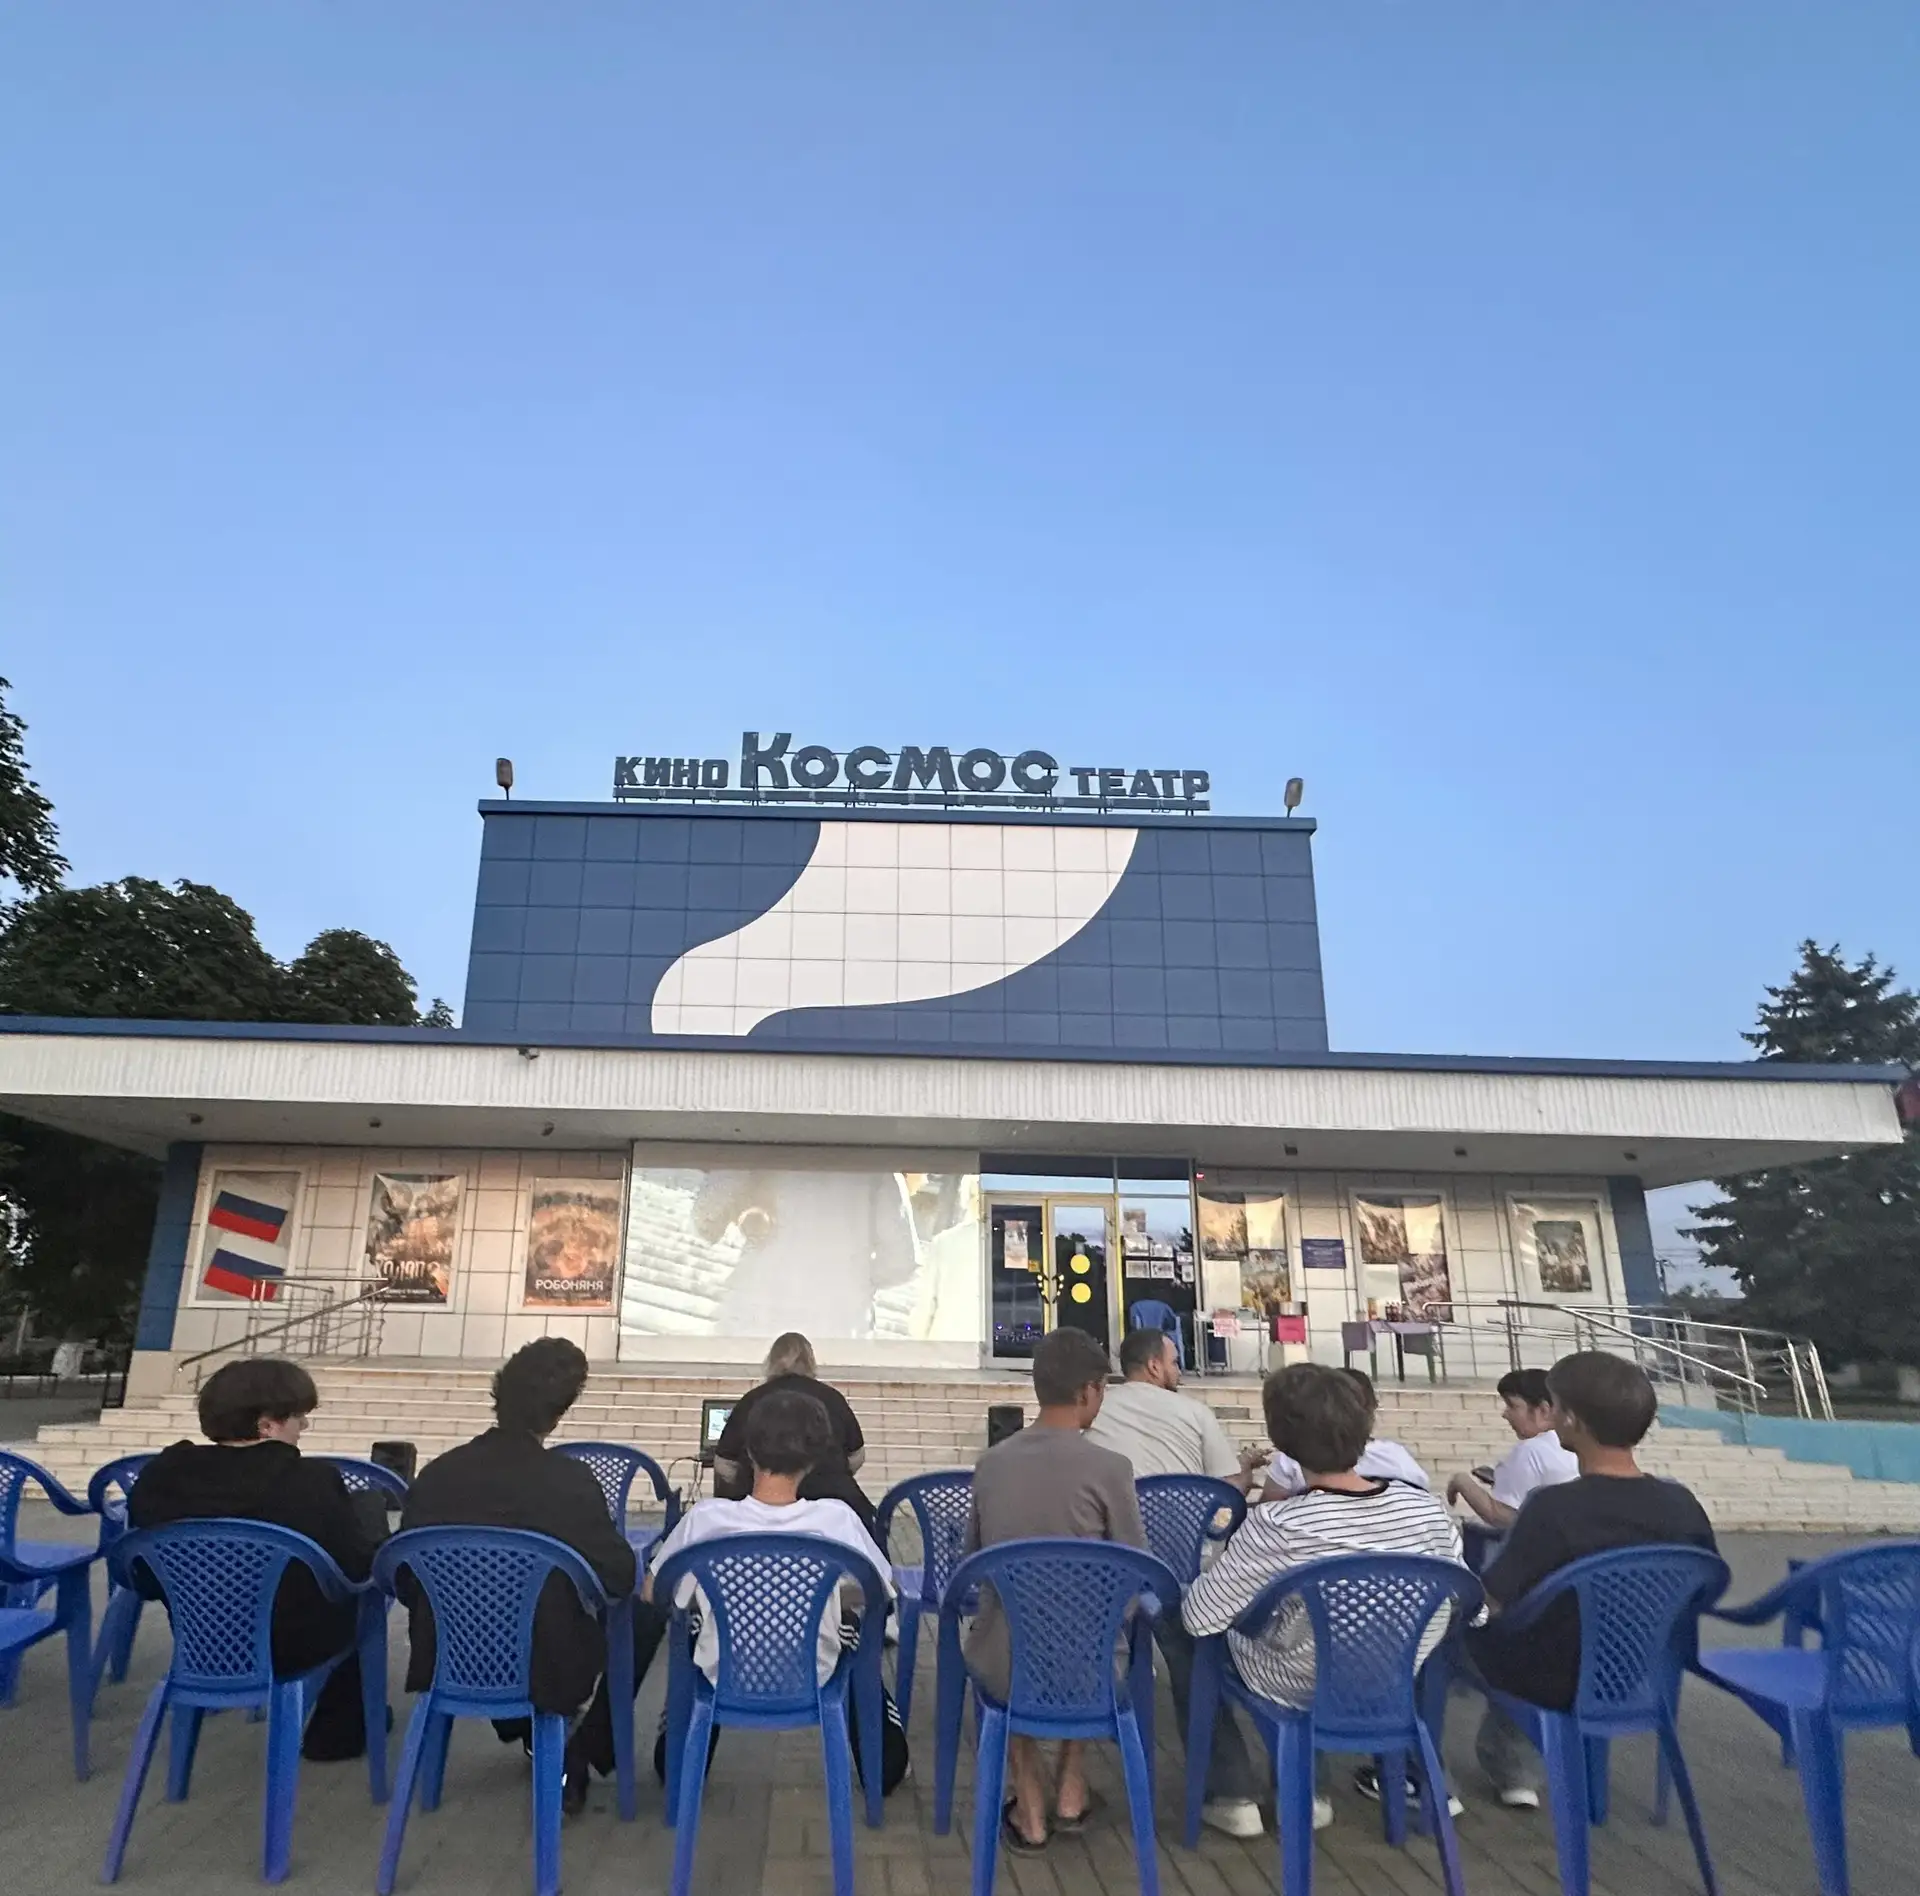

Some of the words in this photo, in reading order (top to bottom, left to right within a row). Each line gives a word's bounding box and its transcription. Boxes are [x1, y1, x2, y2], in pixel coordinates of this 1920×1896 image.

[614, 756, 729, 788] КИНО
[1070, 767, 1210, 799] ТЕАТР
[535, 1279, 604, 1291] РОБОНЯНЯ
